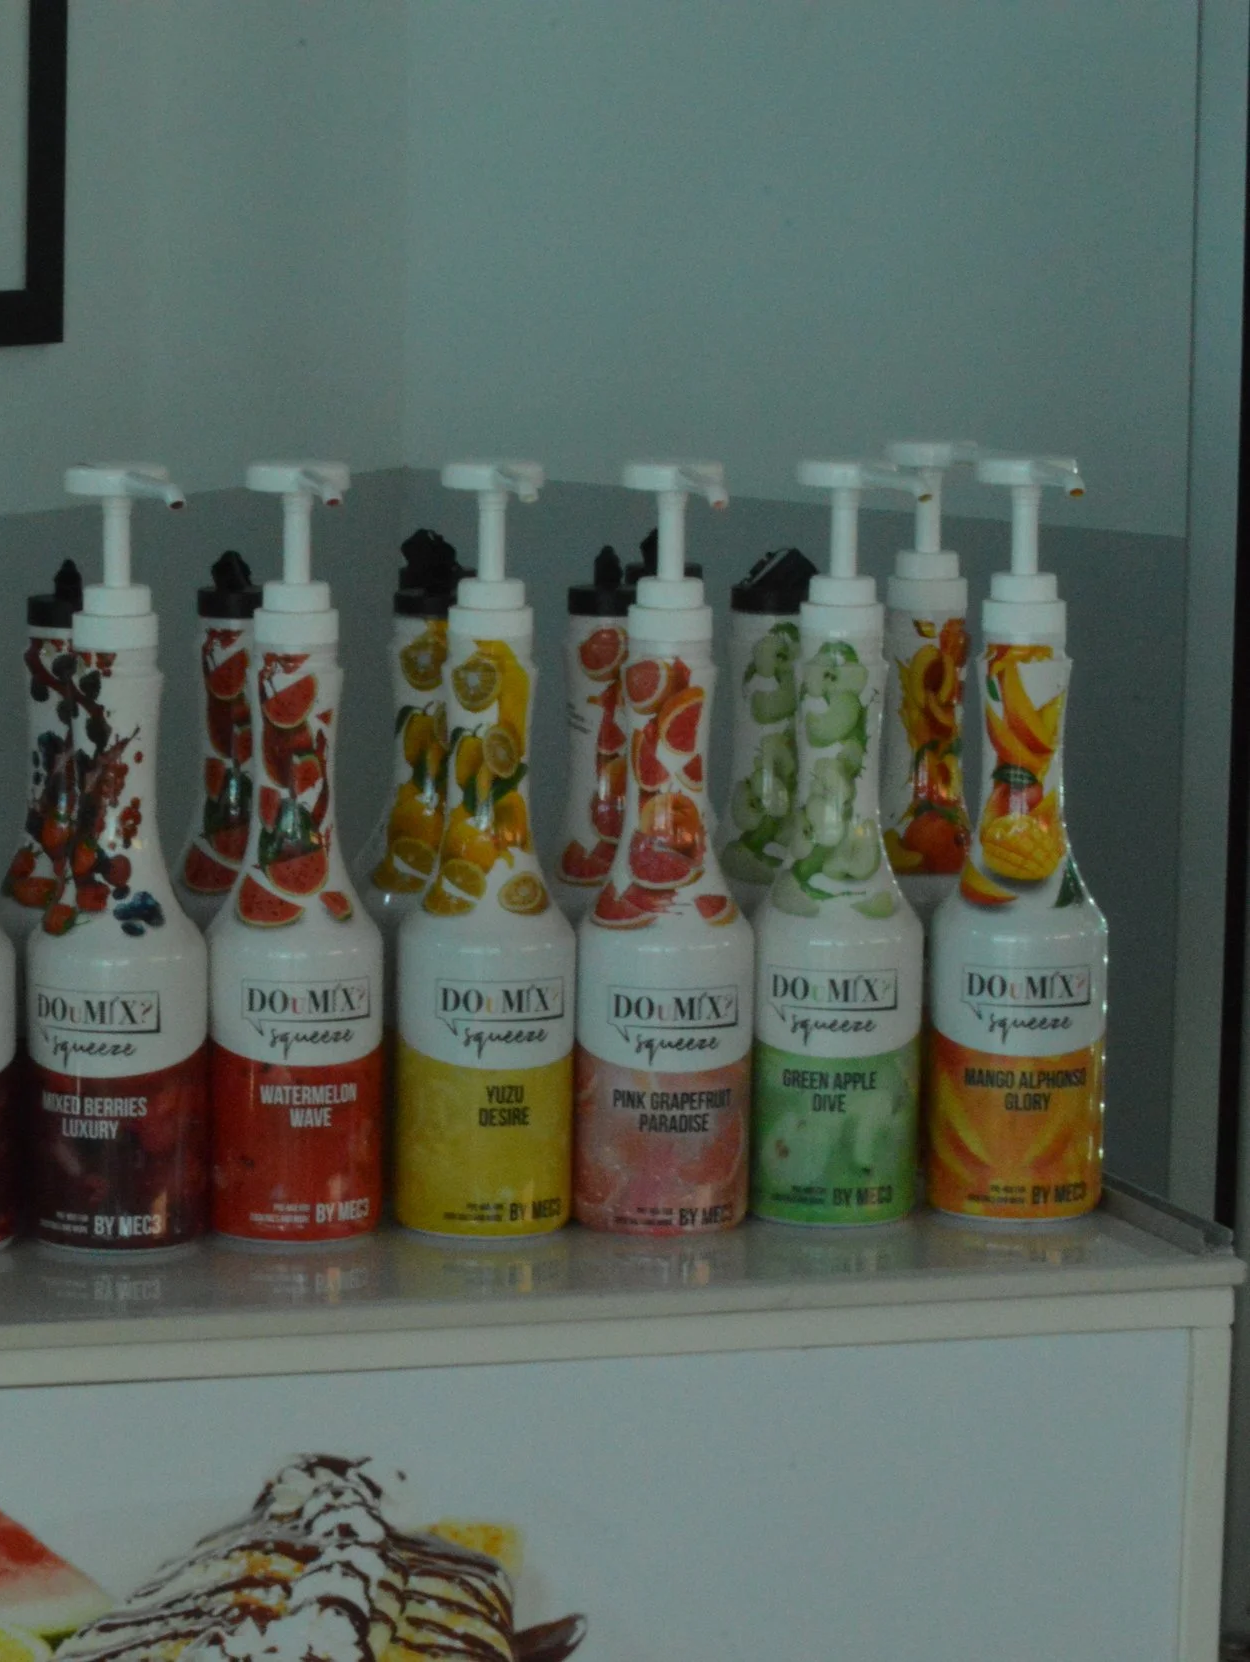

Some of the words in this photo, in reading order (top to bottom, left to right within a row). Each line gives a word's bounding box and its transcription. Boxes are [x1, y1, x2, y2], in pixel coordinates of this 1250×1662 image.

[782, 1068, 829, 1088] GREEN
[833, 1071, 877, 1089] APPLE
[965, 1067, 1014, 1088] MANGO
[260, 1082, 358, 1106] WATERMELON
[486, 1085, 524, 1104] YUZU
[613, 1088, 647, 1108] PINK
[650, 1089, 732, 1111] GRAPEFRUIT
[812, 1093, 846, 1112] DIVE
[1004, 1090, 1051, 1111] GLORY
[84, 1096, 148, 1118] BERRIES
[478, 1107, 530, 1127] DESIRE
[289, 1107, 333, 1128] WAVE
[638, 1113, 710, 1132] PARADISE
[61, 1119, 120, 1141] LUXURY
[833, 1187, 852, 1205] BY
[1031, 1187, 1050, 1205] BY
[315, 1205, 335, 1225] BY
[509, 1203, 527, 1221] BY
[679, 1207, 698, 1226] BY
[93, 1215, 116, 1236] BY
[119, 1214, 162, 1236] MEC3
